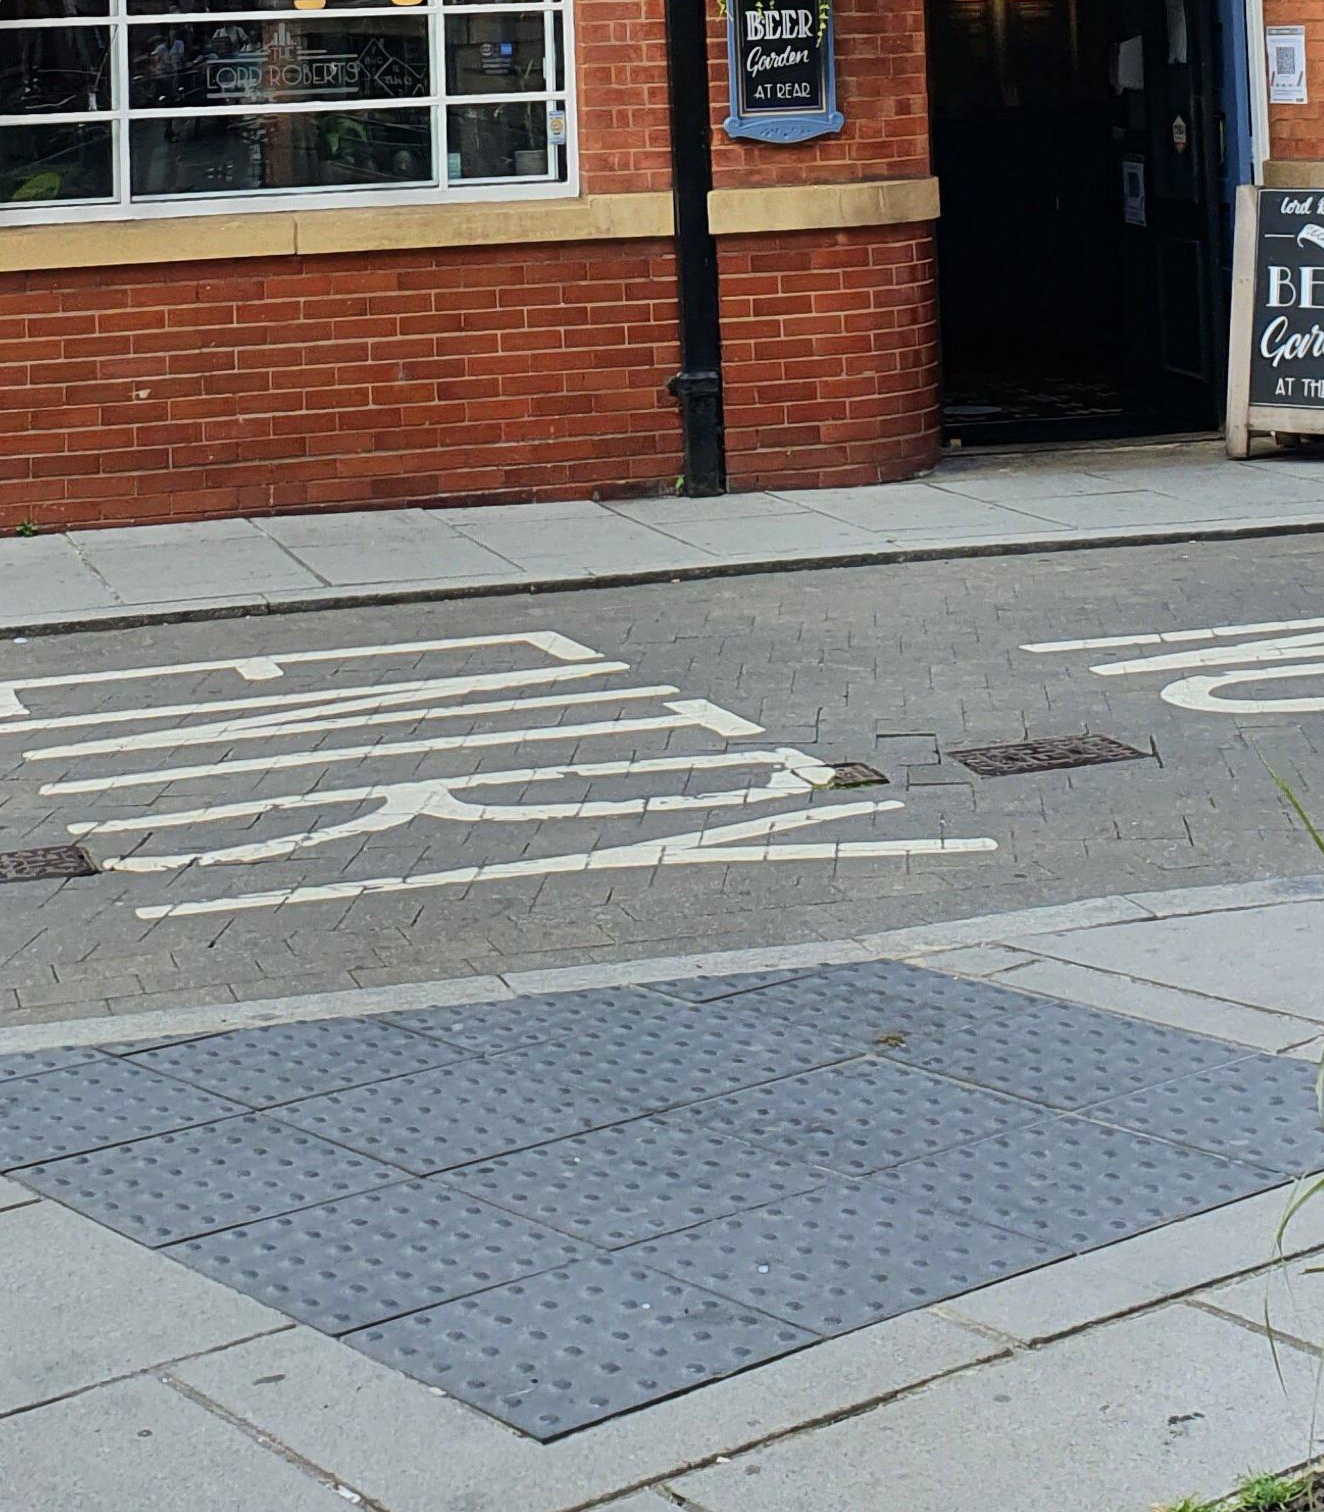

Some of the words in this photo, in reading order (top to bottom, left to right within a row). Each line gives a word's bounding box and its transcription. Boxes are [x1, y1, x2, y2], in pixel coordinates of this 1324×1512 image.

[745, 10, 814, 41] BEER
[746, 45, 810, 78] Garden
[269, 62, 360, 86] ROBERTS
[753, 84, 773, 99] AT
[777, 82, 811, 98] REAR
[1275, 377, 1296, 396] AT
